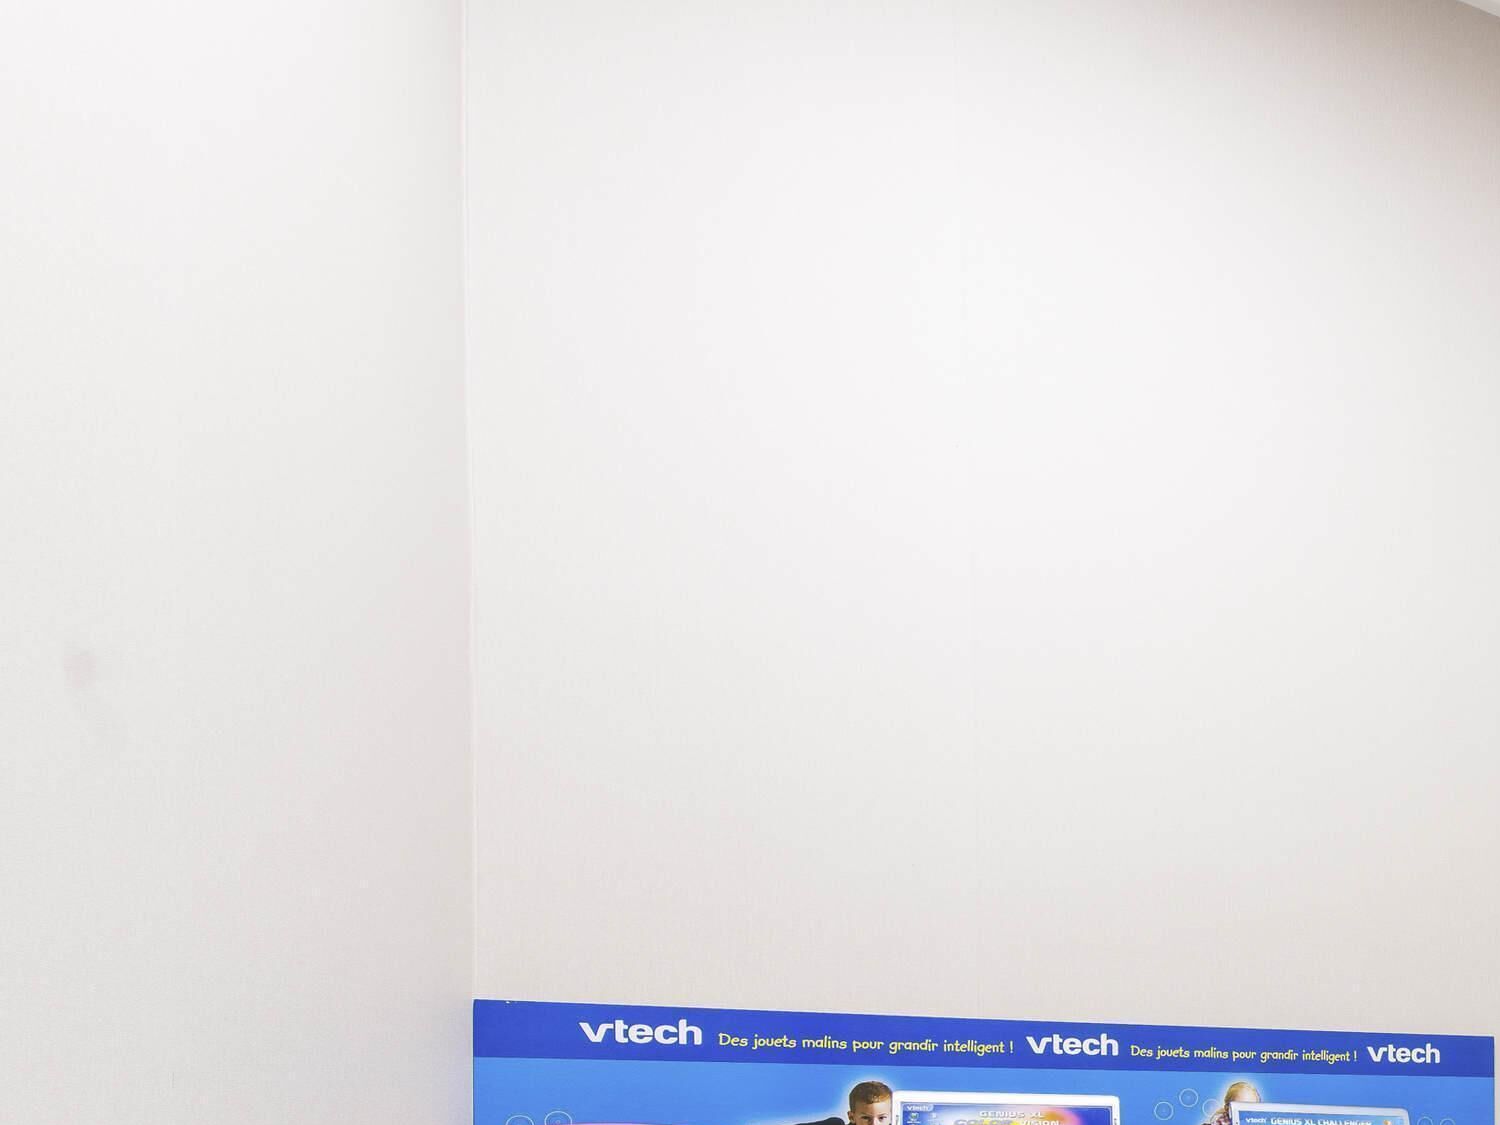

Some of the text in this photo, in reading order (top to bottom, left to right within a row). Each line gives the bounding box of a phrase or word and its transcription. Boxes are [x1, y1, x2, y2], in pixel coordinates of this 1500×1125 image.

[578, 1018, 702, 1046] vtech
[718, 1032, 1014, 1057] Des jouets malins pour grandir intelligent !
[1026, 1033, 1119, 1057] vtech
[1130, 1044, 1357, 1065] Des jouets malins pour grandir intelligent !
[1366, 1043, 1441, 1064] vtech
[979, 1110, 1025, 1119] GENIUS
[1270, 1118, 1302, 1125] GENIUS
